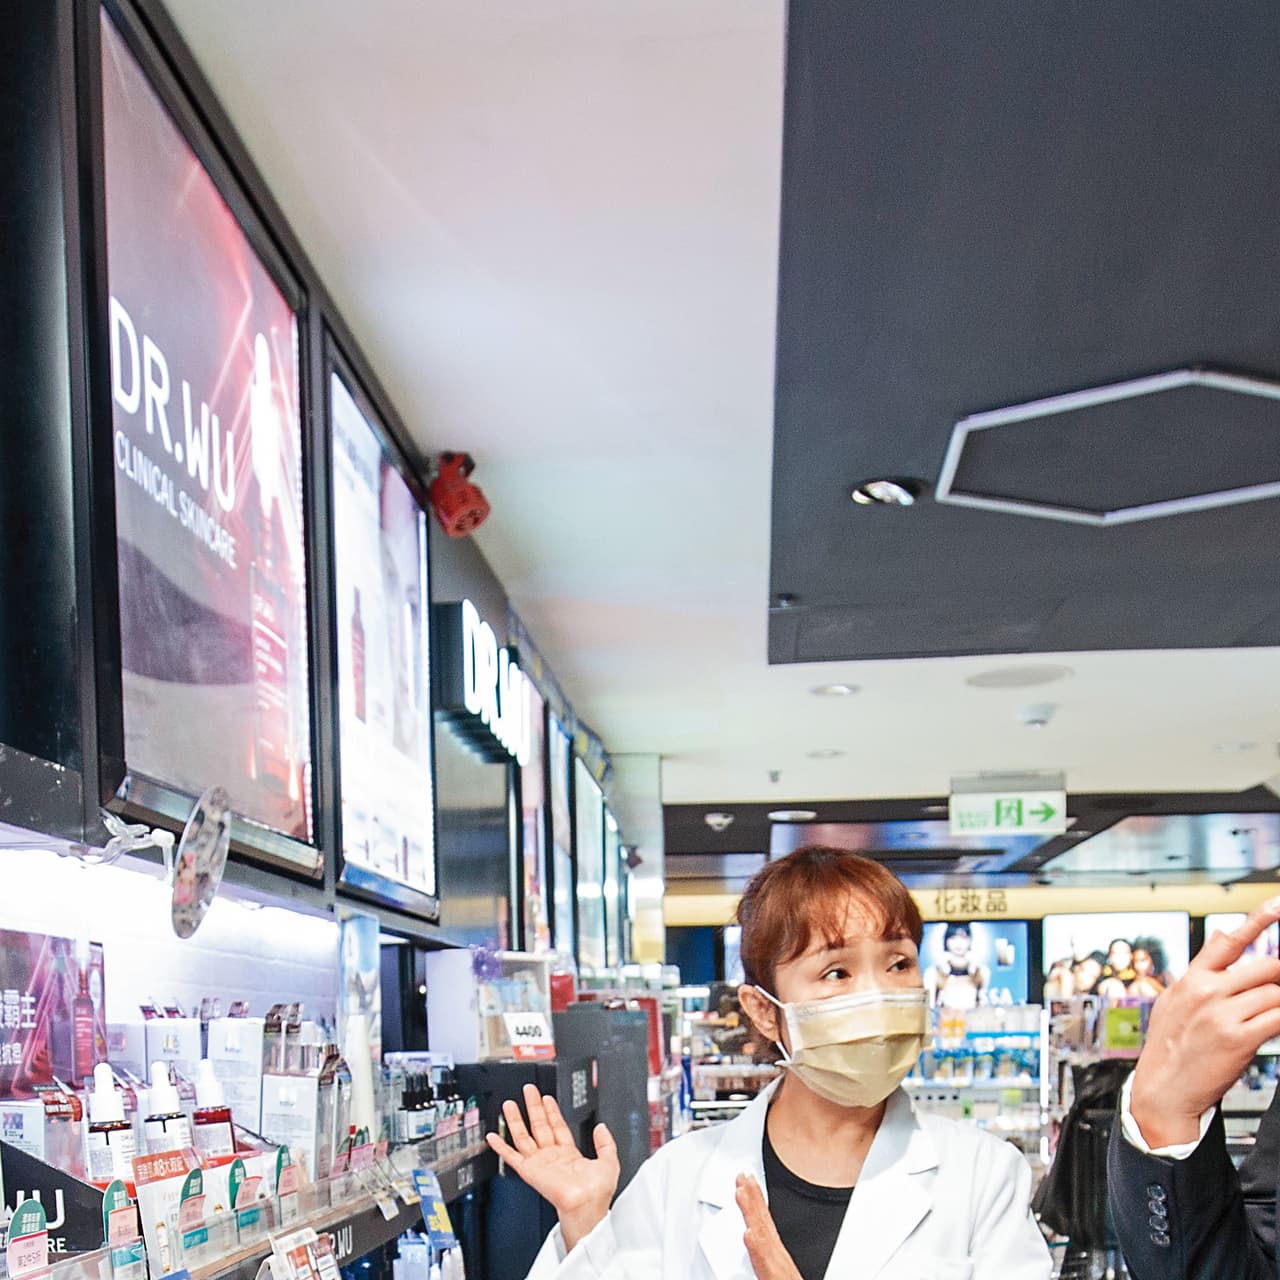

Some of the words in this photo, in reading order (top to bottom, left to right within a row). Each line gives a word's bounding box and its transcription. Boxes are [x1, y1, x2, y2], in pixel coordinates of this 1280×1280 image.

[110, 295, 236, 513] DR.WU
[114, 429, 179, 520] CLINICAL
[179, 494, 238, 570] SKINCARE
[462, 598, 529, 767] DR.WU
[332, 1224, 353, 1260] .WU
